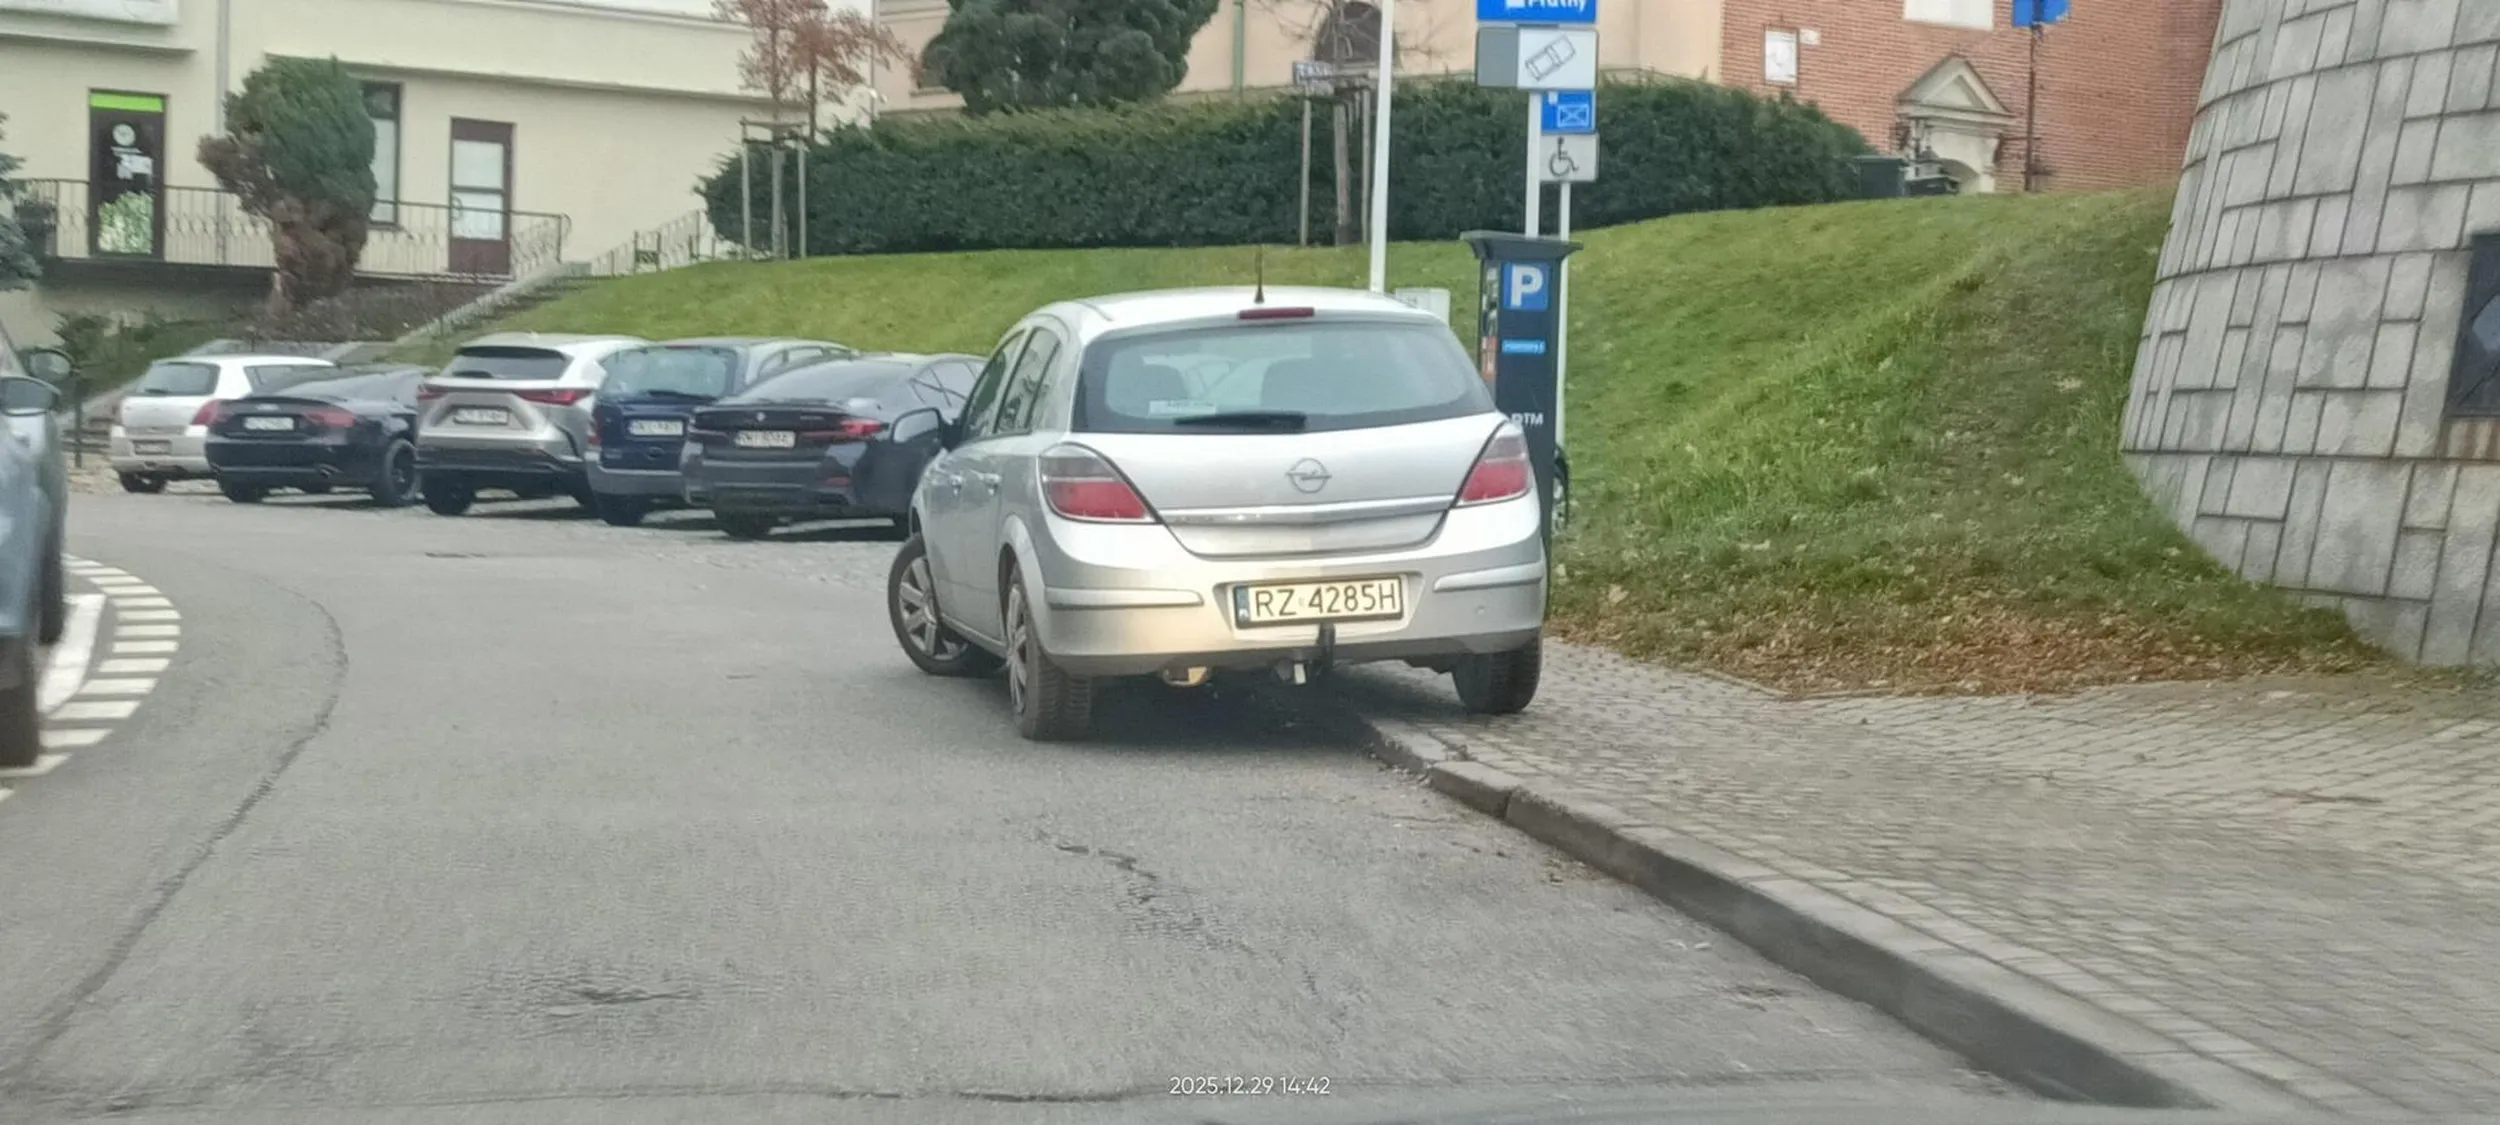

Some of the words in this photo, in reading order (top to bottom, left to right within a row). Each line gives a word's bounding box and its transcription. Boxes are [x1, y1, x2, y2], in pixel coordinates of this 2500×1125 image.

[1510, 264, 1543, 308] P
[1255, 588, 1296, 617] RZ
[1308, 583, 1396, 614] 4285H
